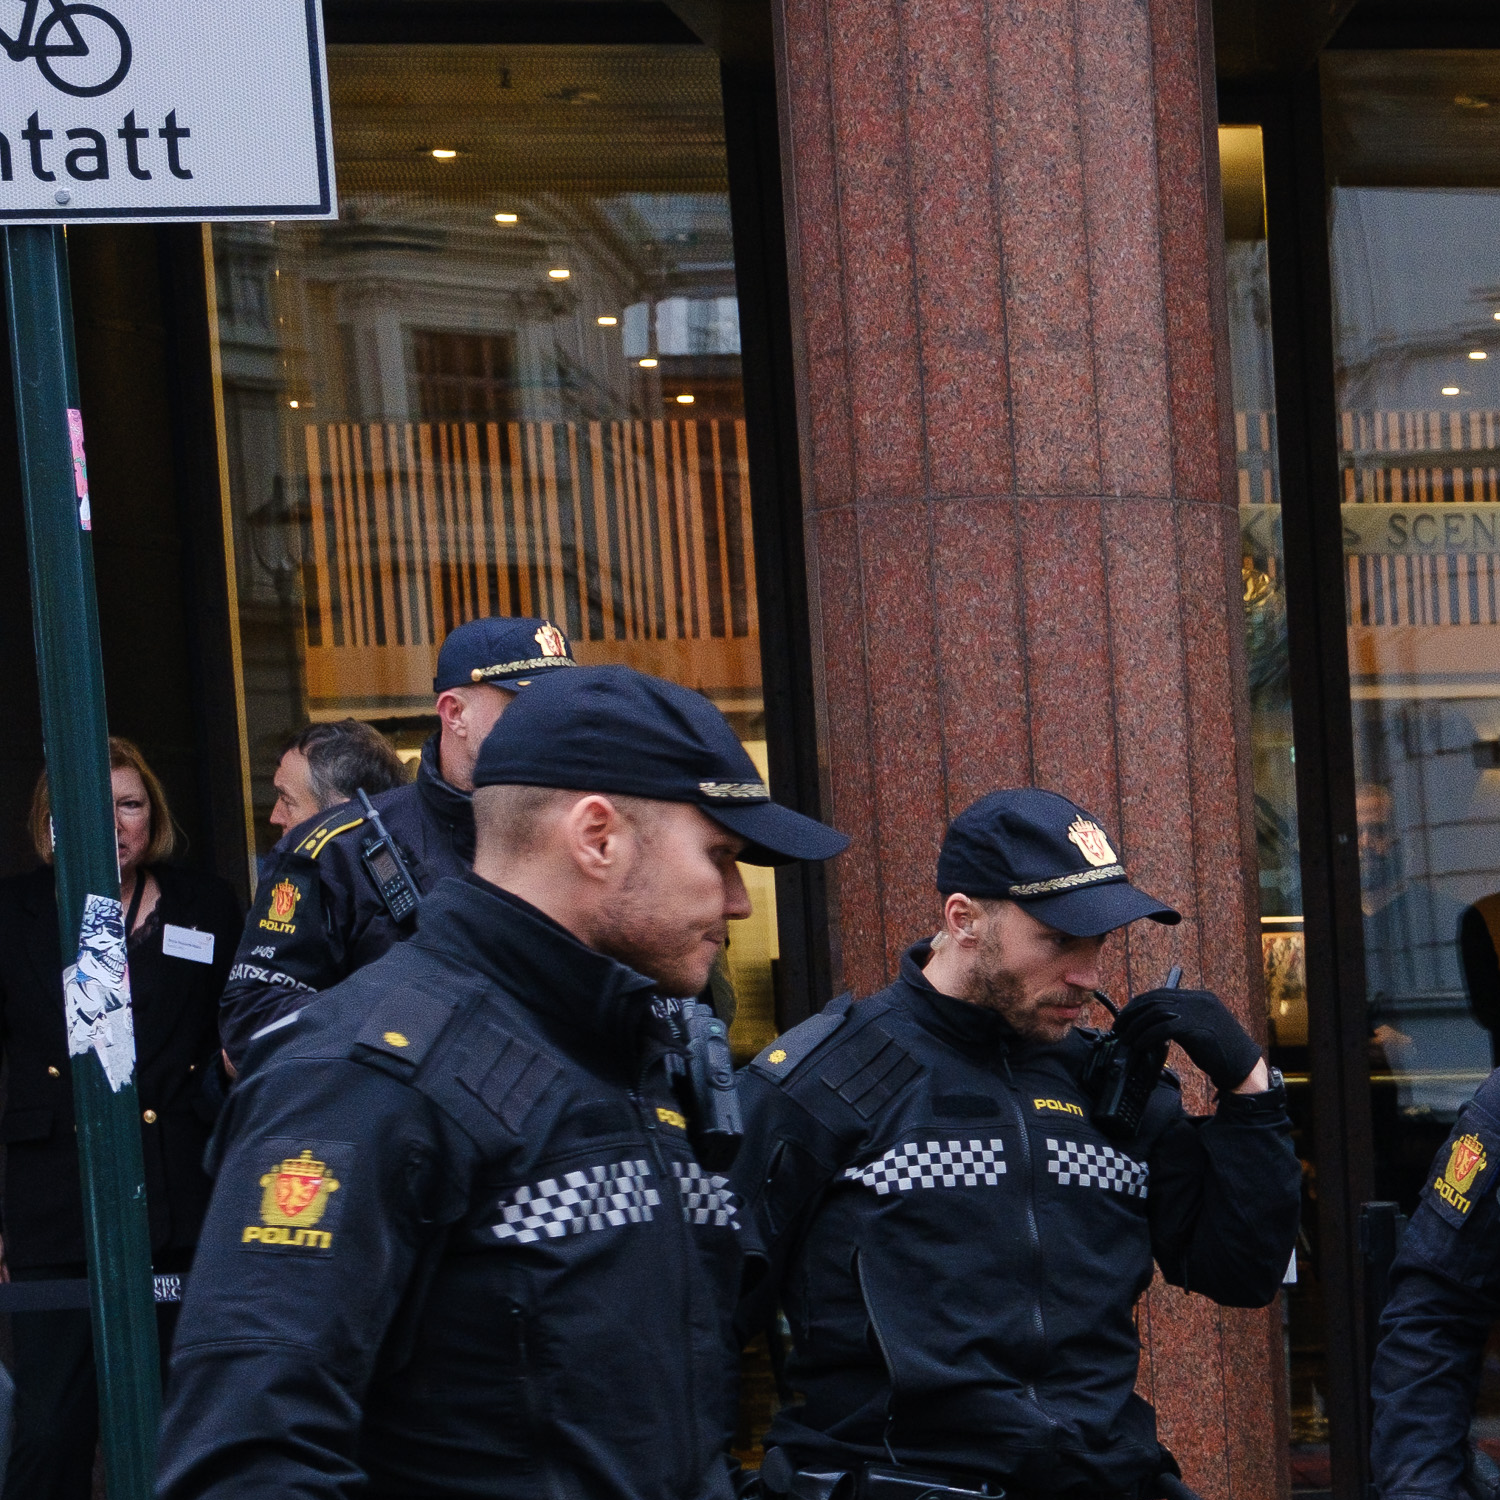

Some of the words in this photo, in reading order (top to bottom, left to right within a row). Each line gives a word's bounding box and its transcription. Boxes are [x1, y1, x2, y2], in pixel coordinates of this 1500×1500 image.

[259, 920, 296, 935] POLITI
[1033, 1098, 1084, 1117] POLITI
[1434, 1176, 1471, 1214] POLITI
[241, 1226, 333, 1249] POLITI
